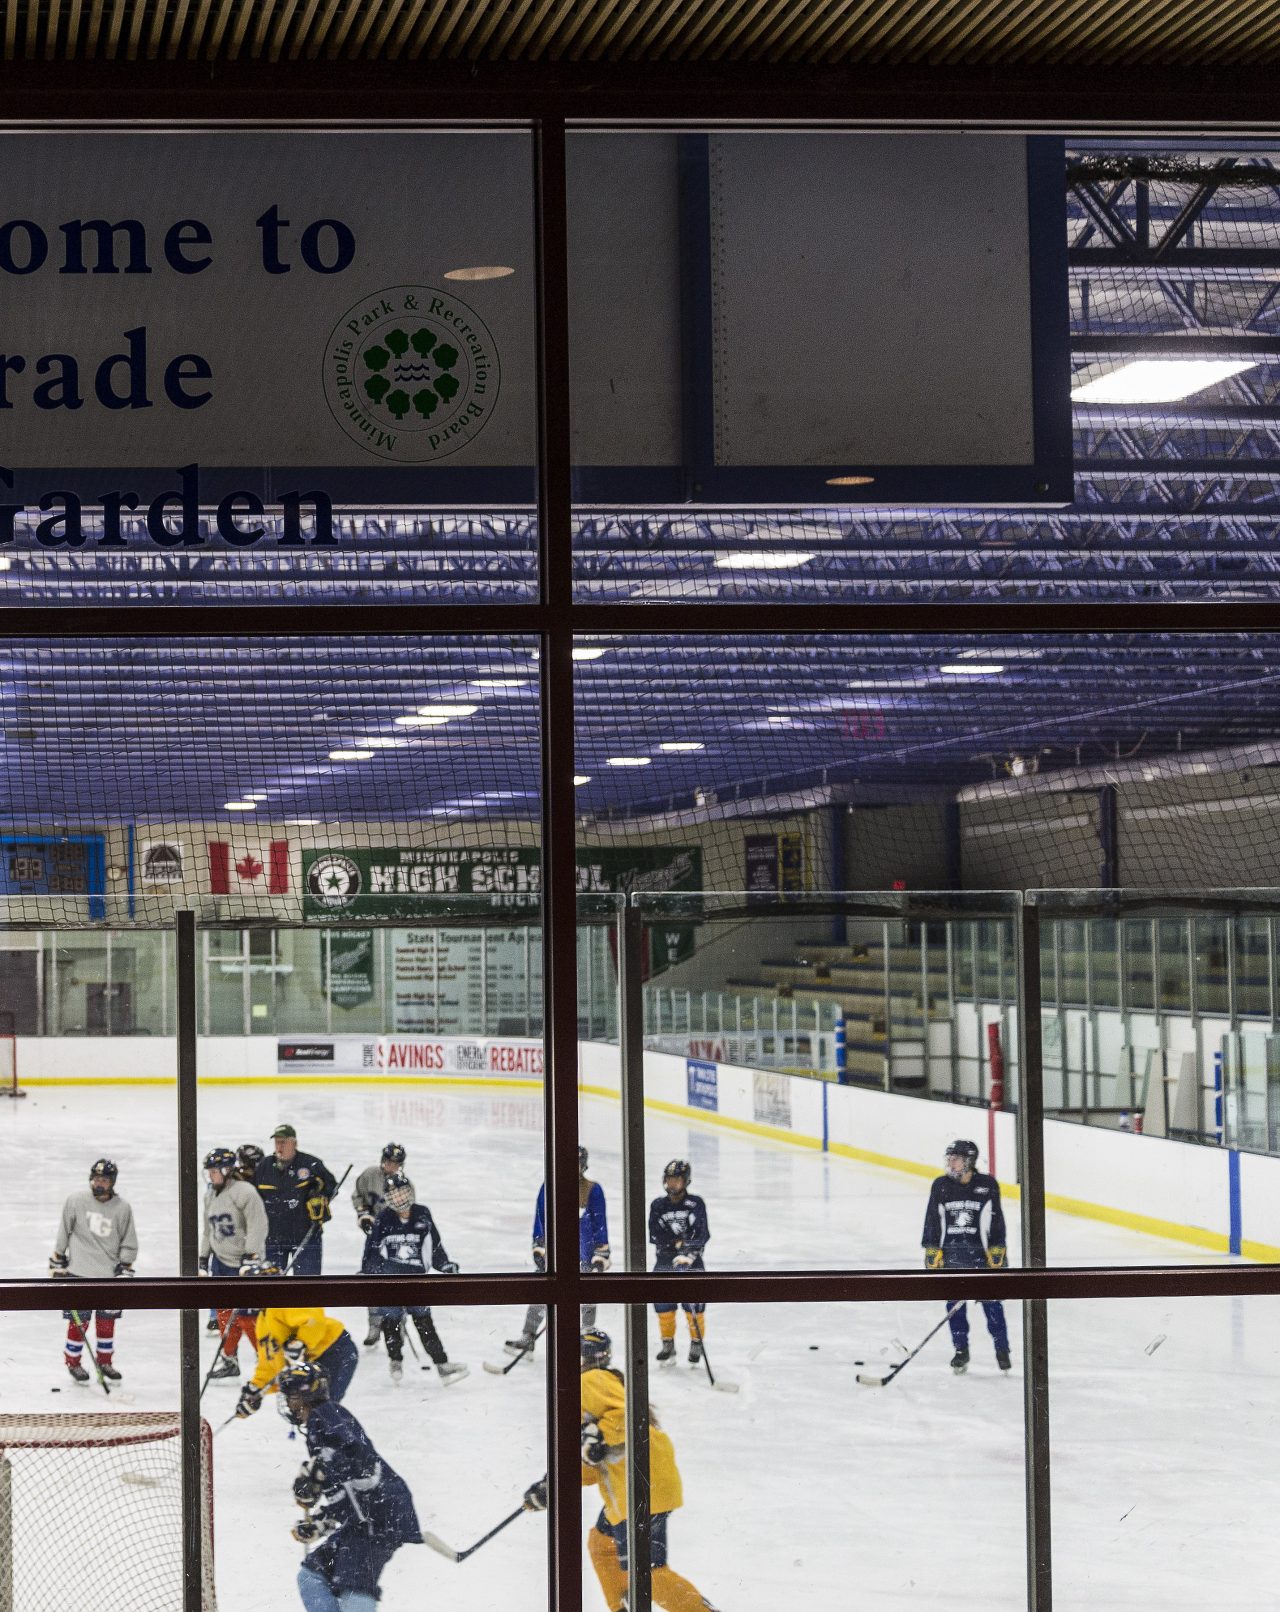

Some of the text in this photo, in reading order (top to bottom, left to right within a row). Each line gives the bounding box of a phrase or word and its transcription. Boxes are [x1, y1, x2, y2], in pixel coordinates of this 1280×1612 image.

[256, 204, 356, 275] to
[333, 294, 491, 451] Minneapolis Park & Recreation Board
[399, 851, 519, 864] MINNEAPOLIS
[370, 865, 460, 893] HIGH
[407, 932, 434, 943] State
[490, 1046, 543, 1073] REBATES
